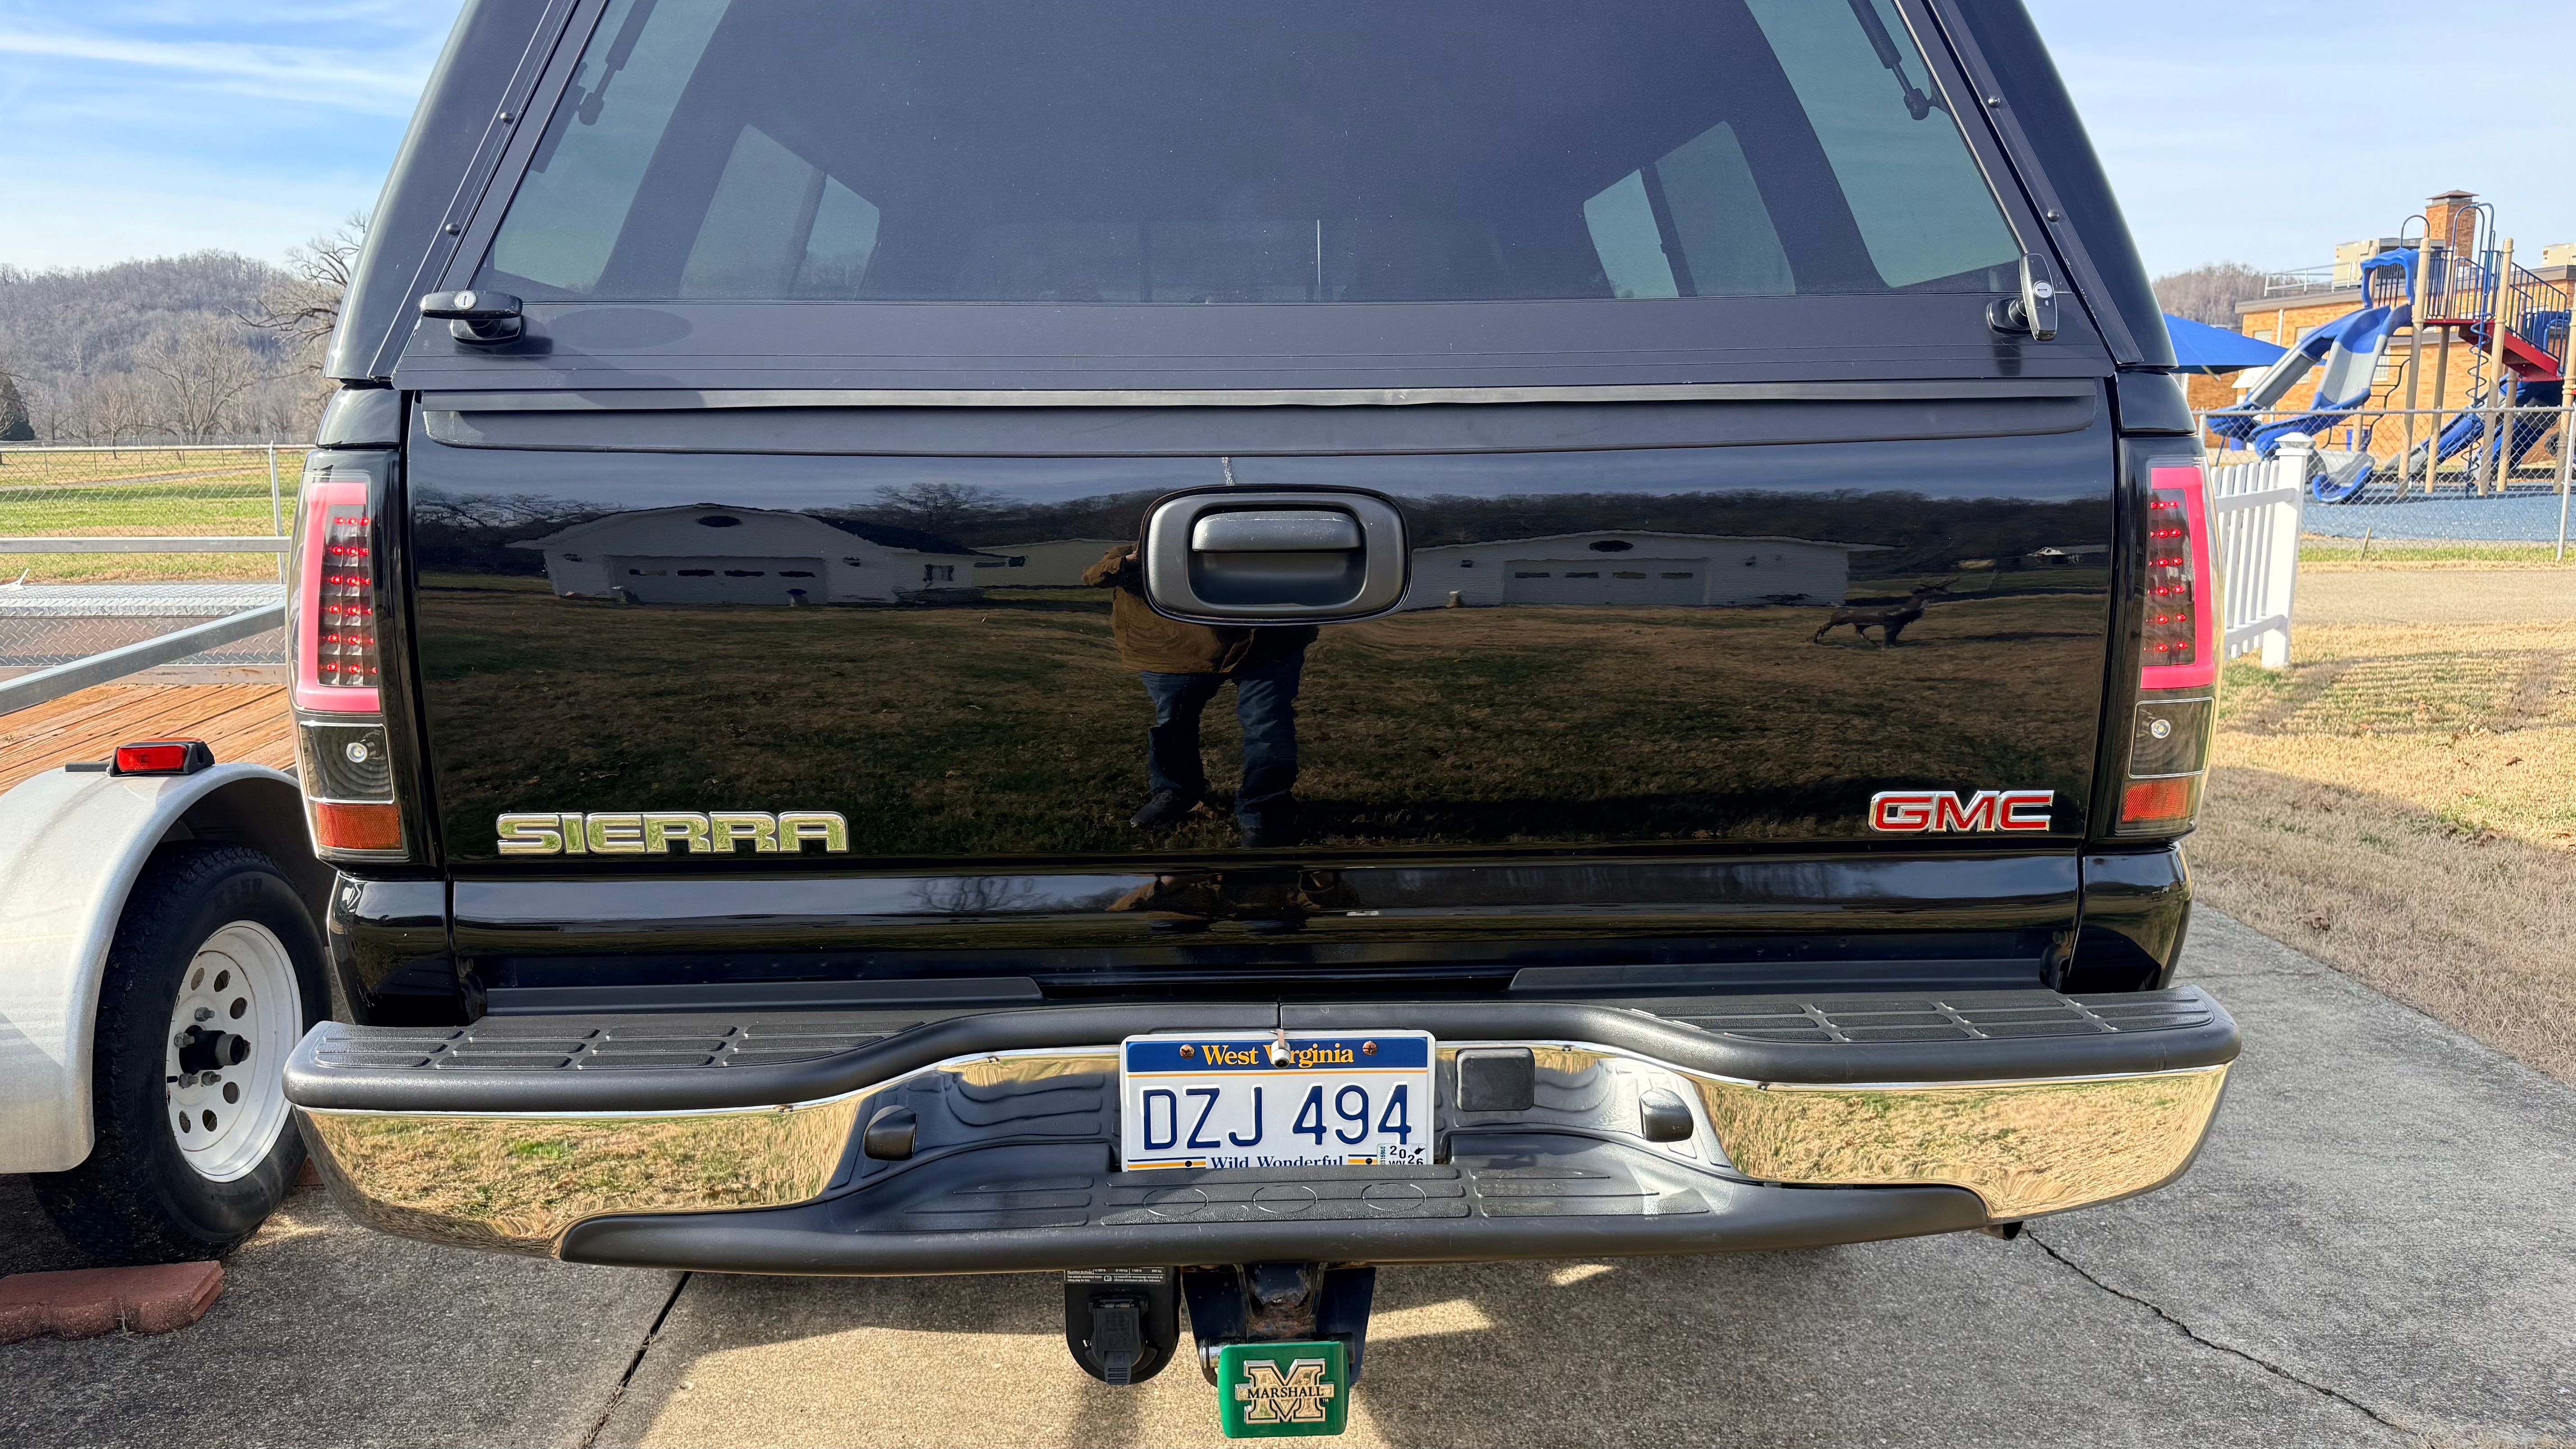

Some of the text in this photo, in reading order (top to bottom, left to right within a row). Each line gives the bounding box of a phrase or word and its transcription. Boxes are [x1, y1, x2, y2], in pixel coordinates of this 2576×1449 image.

[1868, 790, 2054, 833] GMC
[496, 811, 850, 855] SIERRA
[1201, 1043, 1354, 1068] West rginia
[1143, 1084, 1412, 1151] DZJ 494
[1210, 1155, 1343, 1169] Wild Wonderful
[1389, 1145, 1424, 1164] 2026
[1247, 1386, 1324, 1399] MARSHALL
